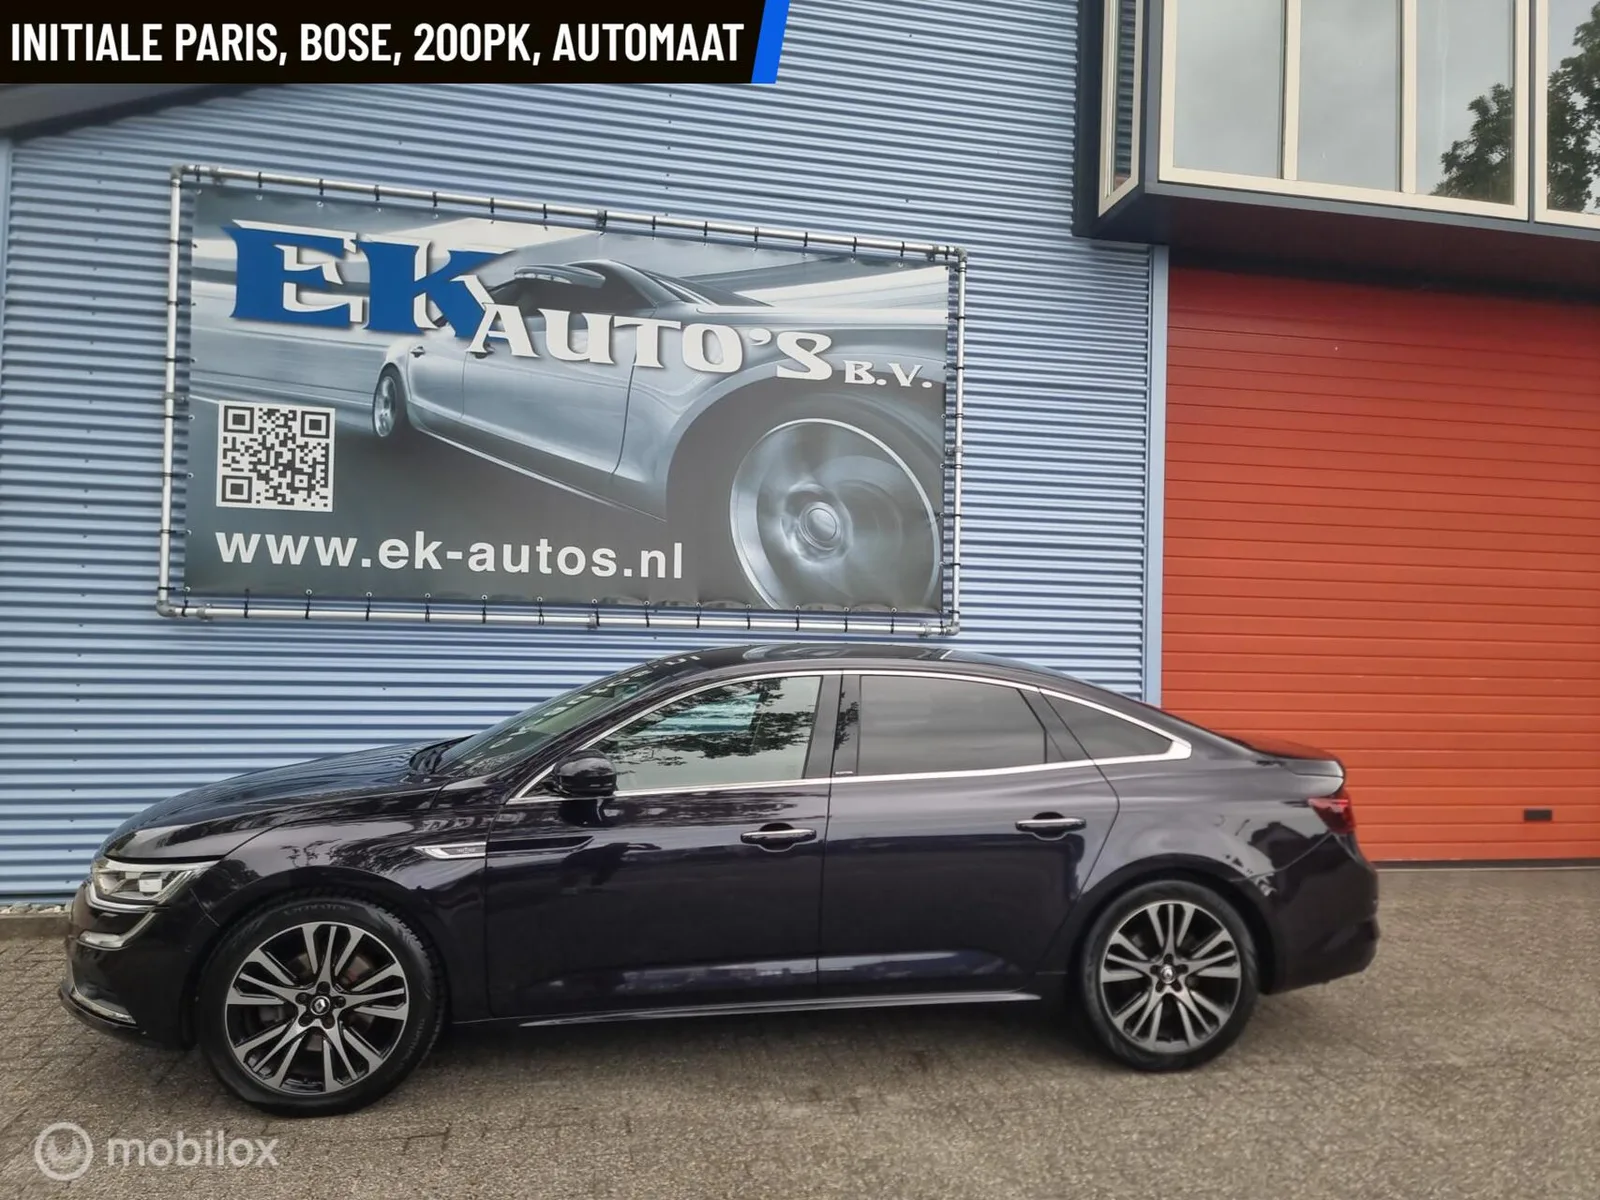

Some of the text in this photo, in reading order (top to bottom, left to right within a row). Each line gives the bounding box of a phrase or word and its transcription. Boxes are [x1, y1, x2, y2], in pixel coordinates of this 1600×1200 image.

[221, 219, 514, 338] EK
[844, 360, 932, 387] B.V.
[215, 530, 682, 579] www.ek-autos.nl
